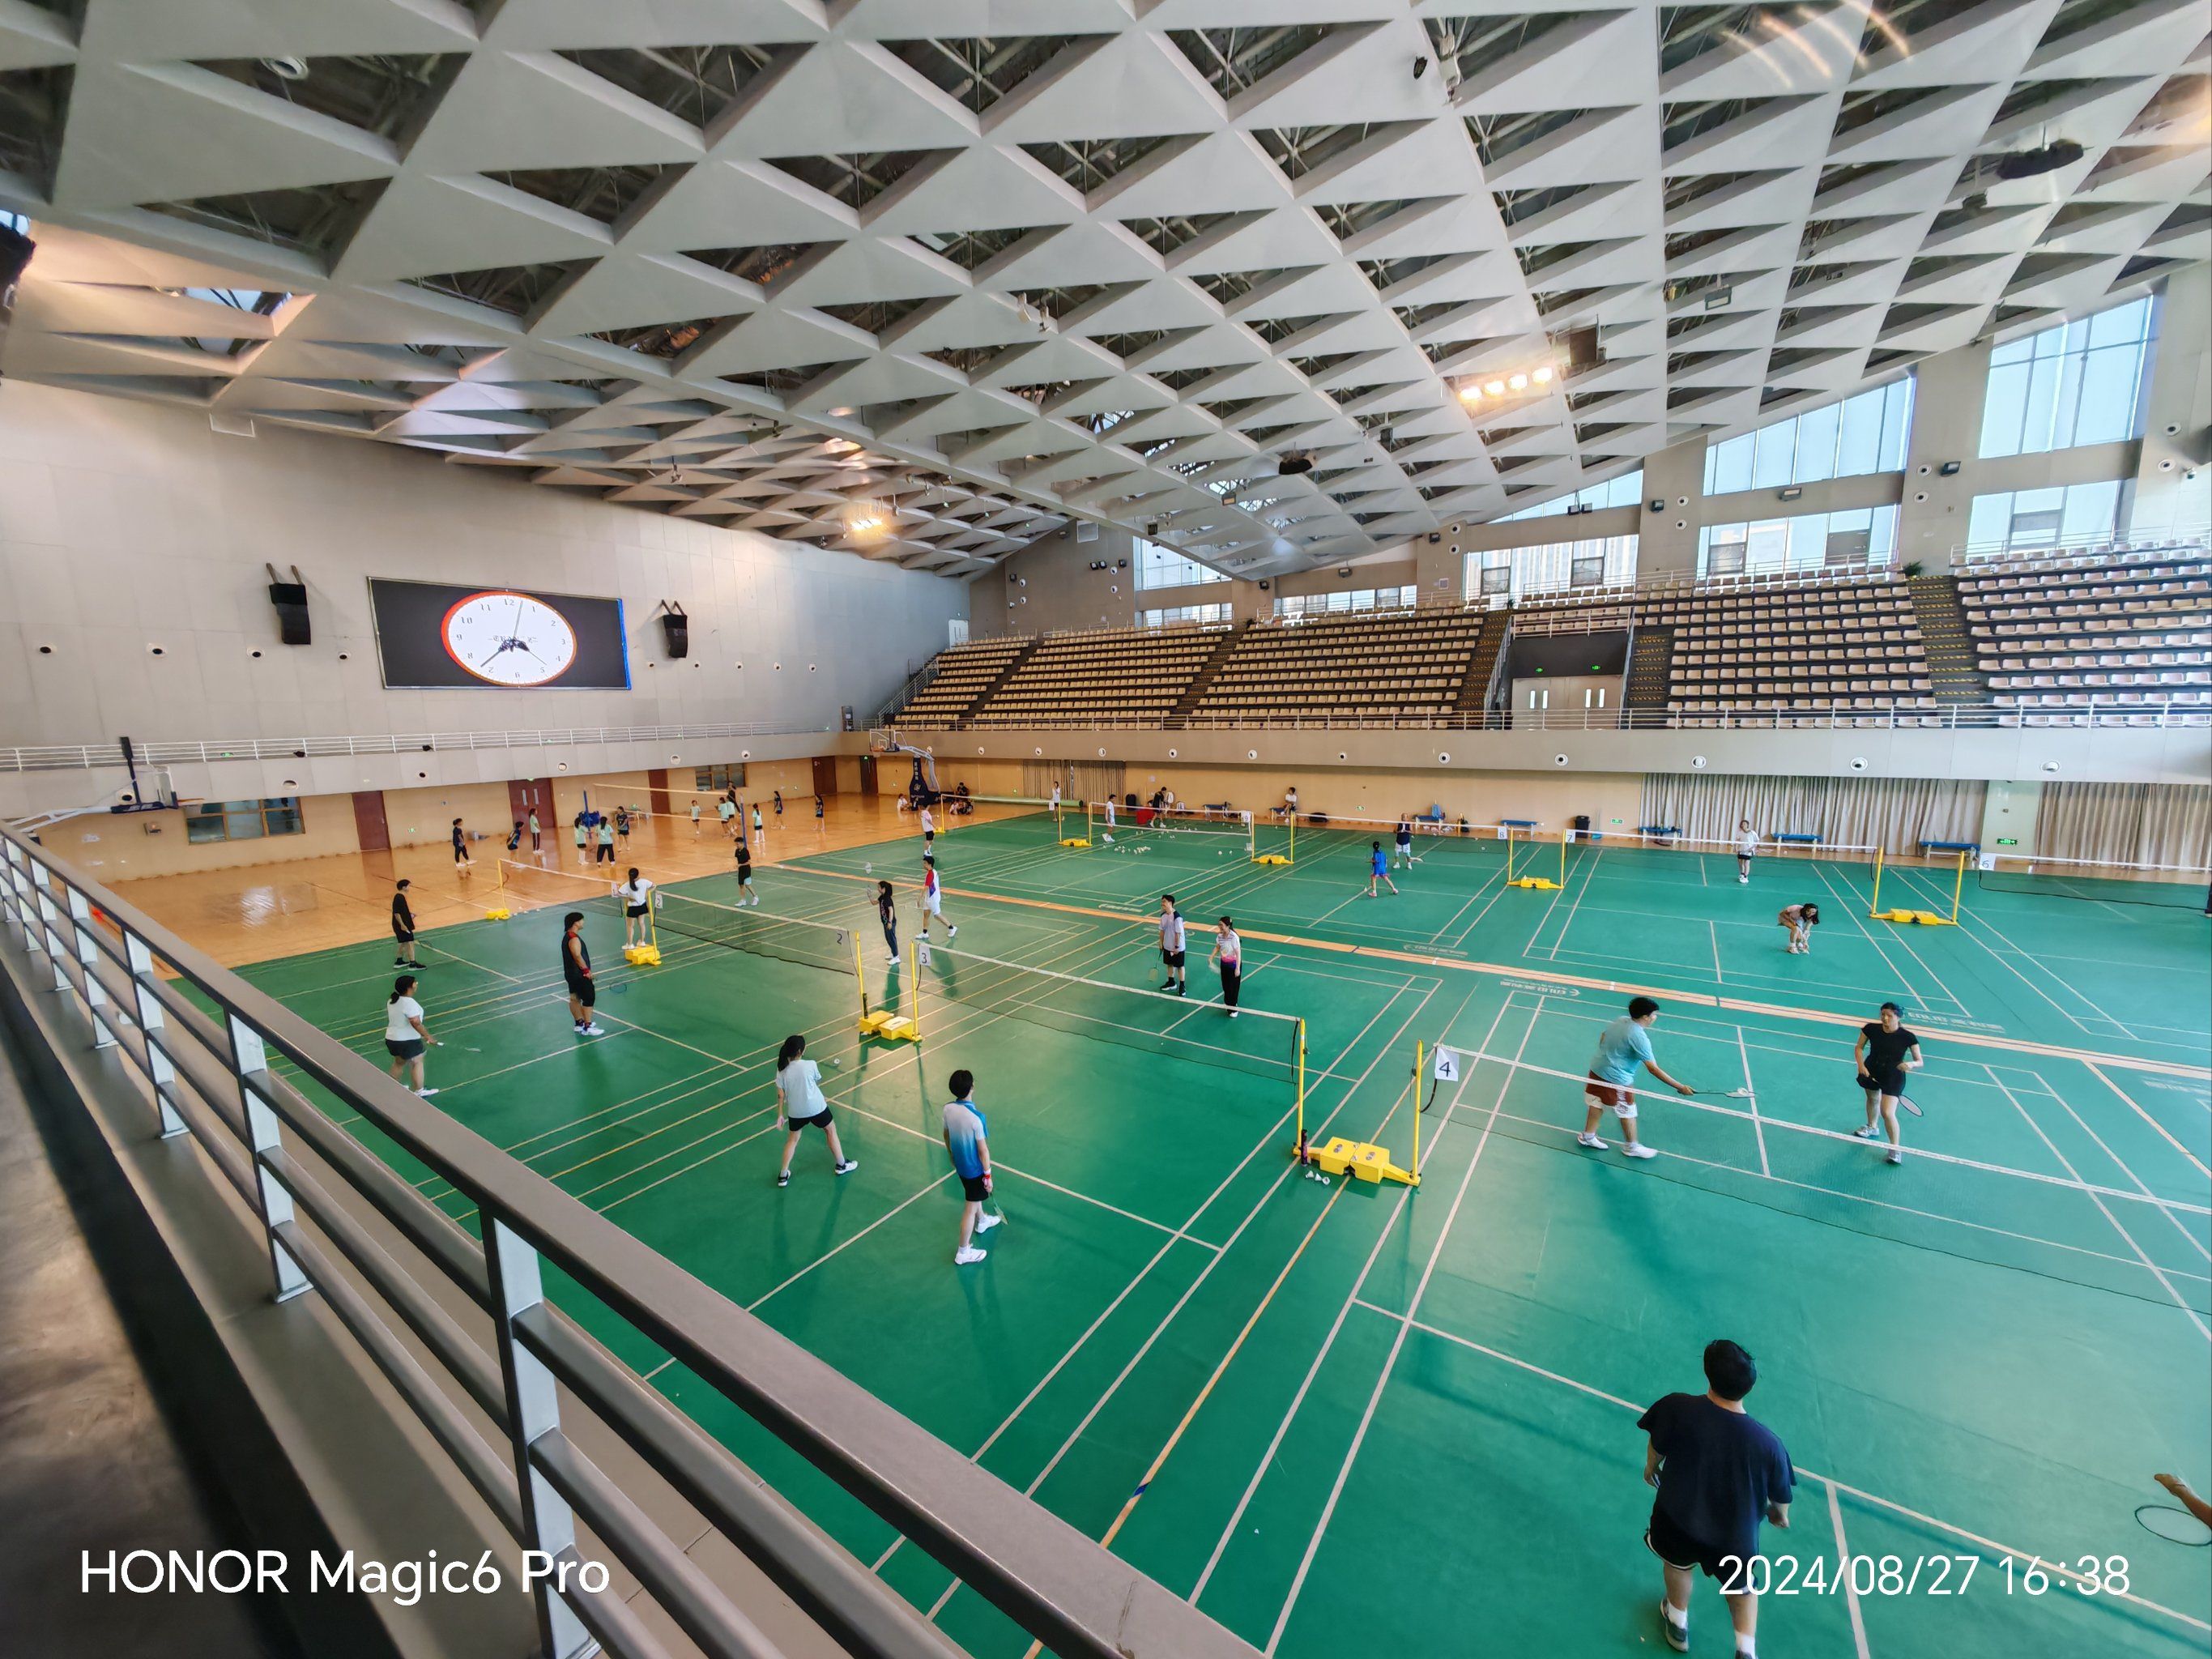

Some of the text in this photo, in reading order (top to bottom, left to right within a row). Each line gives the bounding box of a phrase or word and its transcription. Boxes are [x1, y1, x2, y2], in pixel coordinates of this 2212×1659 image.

[480, 603, 491, 612] 11
[1566, 834, 1573, 842] 7
[1981, 859, 1990, 869] 6
[837, 932, 842, 945] 2
[921, 953, 927, 964] 3
[1438, 1061, 1451, 1077] 4
